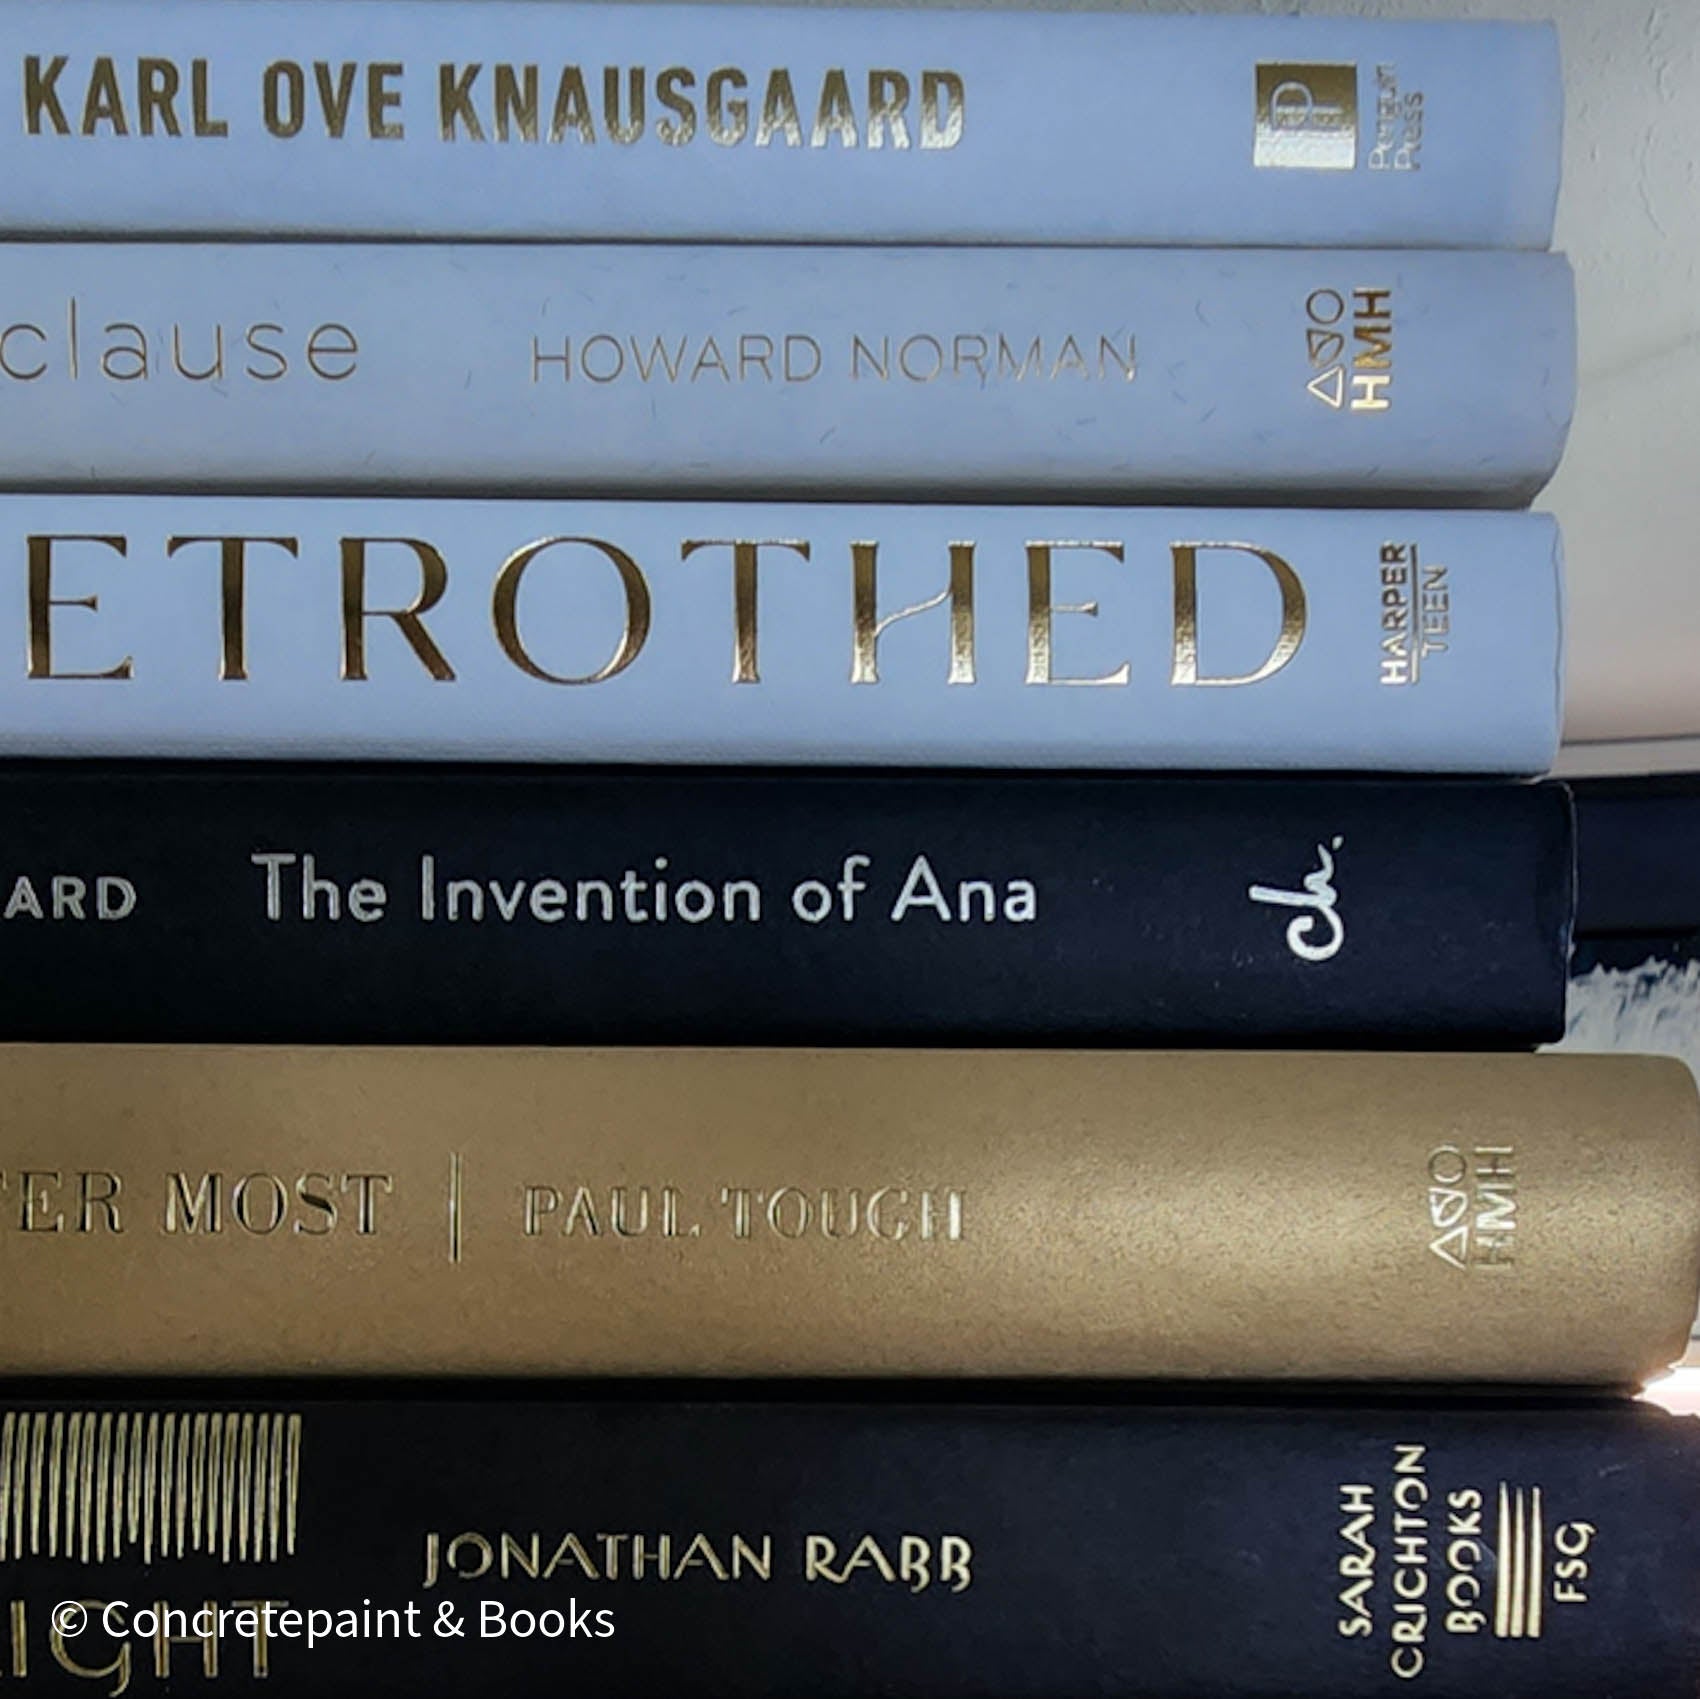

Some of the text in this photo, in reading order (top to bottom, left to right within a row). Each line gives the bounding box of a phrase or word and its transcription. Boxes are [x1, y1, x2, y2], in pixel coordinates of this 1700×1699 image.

[23, 55, 966, 150] KARL OVE KNAUSGAARD
[1394, 90, 1423, 171] Press
[0, 296, 359, 381] clause
[532, 333, 1138, 386] HOWARD NORMAN
[1350, 287, 1392, 410] HMH
[26, 535, 1308, 685] ETROTHED
[1379, 542, 1409, 686] HARPER
[1420, 563, 1449, 658] TEEN
[3, 876, 137, 920] ARD
[251, 853, 1038, 923] The Invention of Ana
[0, 1171, 967, 1241] ER MOST PAUL TOUGH
[1475, 1145, 1515, 1270] HMH
[423, 1533, 973, 1594] JONATHAN RABB
[1338, 1484, 1374, 1638] SARAH
[1390, 1444, 1428, 1679] CRICHTON
[1446, 1488, 1486, 1634] BOOKS
[1554, 1520, 1597, 1604] FSG
[0, 1599, 289, 1698] IGHT
